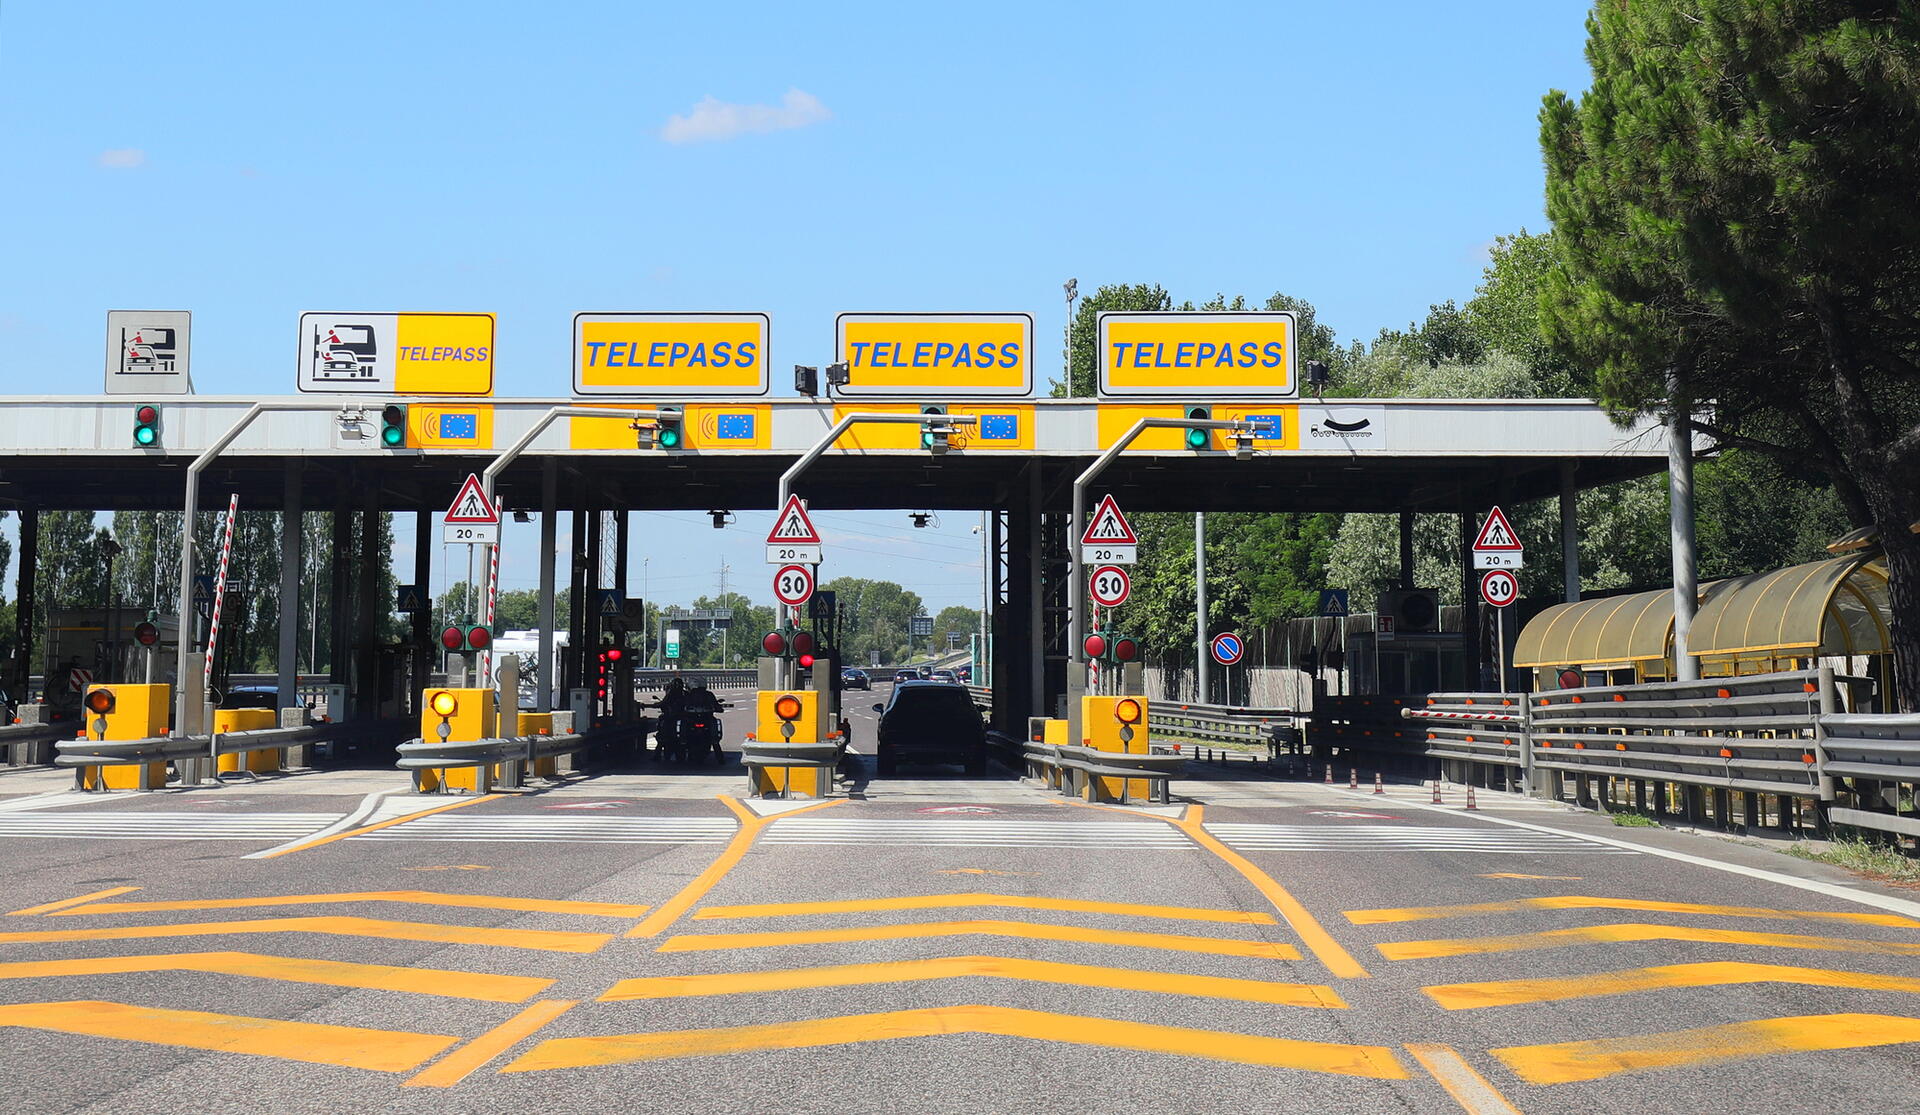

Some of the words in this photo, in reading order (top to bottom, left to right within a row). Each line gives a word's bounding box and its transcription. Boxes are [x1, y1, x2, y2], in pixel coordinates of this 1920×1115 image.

[399, 346, 488, 362] TELEPASS
[586, 340, 756, 368] TELEPASS
[850, 341, 1019, 368] TELEPASS
[1112, 341, 1283, 368] TELEPASS
[456, 529, 472, 539] 20
[779, 549, 795, 559] 20
[1095, 550, 1111, 560] 20
[1485, 556, 1500, 565] 20
[782, 577, 805, 595] 30
[1098, 577, 1122, 596] 30
[1489, 580, 1511, 597] 30
